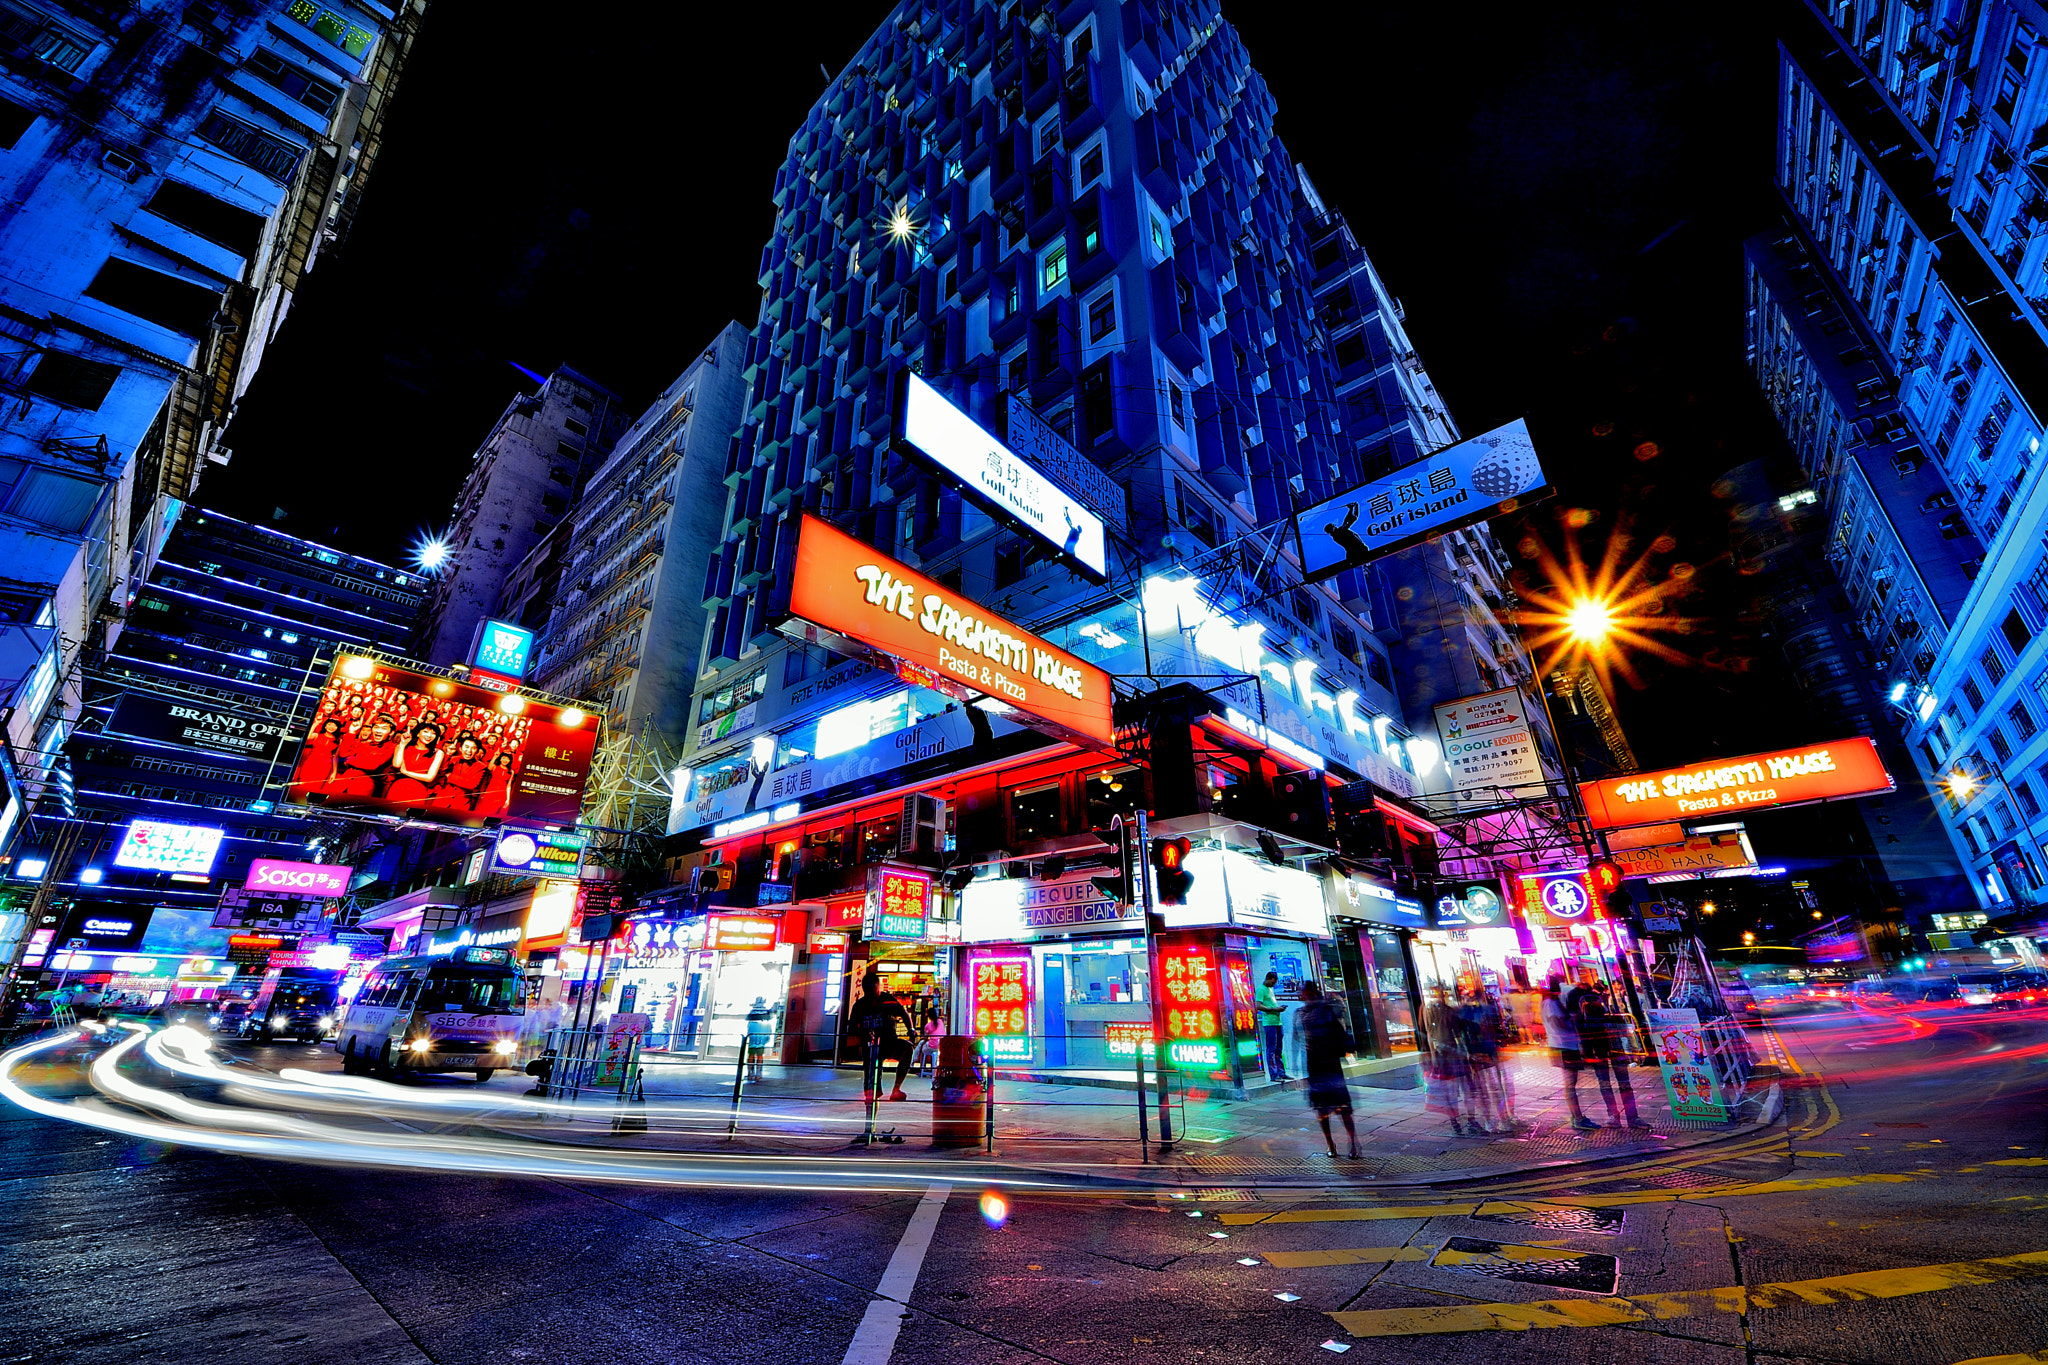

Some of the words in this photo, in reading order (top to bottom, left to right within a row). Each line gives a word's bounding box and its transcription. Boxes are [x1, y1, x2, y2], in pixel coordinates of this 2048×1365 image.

[1034, 436, 1069, 473] TAILOR
[1074, 471, 1079, 480] &
[1084, 479, 1121, 515] OPTICAL
[1055, 468, 1081, 492] PEKING
[1067, 444, 1122, 504] FASHIONS
[1367, 467, 1457, 519] 高球島
[1366, 512, 1406, 537] Golf
[1408, 488, 1469, 522] island
[855, 564, 915, 620] THE
[1032, 647, 1083, 700] HOUSE
[939, 647, 977, 681] Pasta
[979, 665, 993, 686] &
[994, 671, 1026, 702] Pizza
[168, 705, 247, 729] BRAND
[201, 721, 258, 738] TOKYO
[895, 727, 923, 749] Golf
[1321, 725, 1337, 745] Golf
[904, 737, 946, 764] island
[1463, 739, 1494, 752] GOLF
[1494, 733, 1528, 746] TOWN
[544, 746, 570, 762] 樓上
[771, 769, 812, 801] 高球島
[1616, 780, 1660, 803] THE
[1661, 762, 1765, 797] SPAGHETTI
[1766, 750, 1836, 779] HOUSE
[695, 797, 713, 814] Golf
[1678, 795, 1718, 812] Pasta
[1721, 793, 1735, 806] &
[1737, 789, 1777, 803] Pizza
[699, 806, 724, 826] island
[552, 835, 565, 845] TAX
[566, 837, 584, 847] FREE
[534, 846, 579, 862] Nikon
[1636, 860, 1665, 872] RED
[1671, 853, 1724, 869] HAIR
[545, 862, 559, 872] TAX
[560, 864, 577, 874] FREE
[316, 873, 342, 889] 莎莎
[260, 903, 284, 914] ISA
[883, 916, 922, 935] CHANGE
[436, 1017, 467, 1027] SBC
[1171, 1044, 1219, 1064] CHANGE
